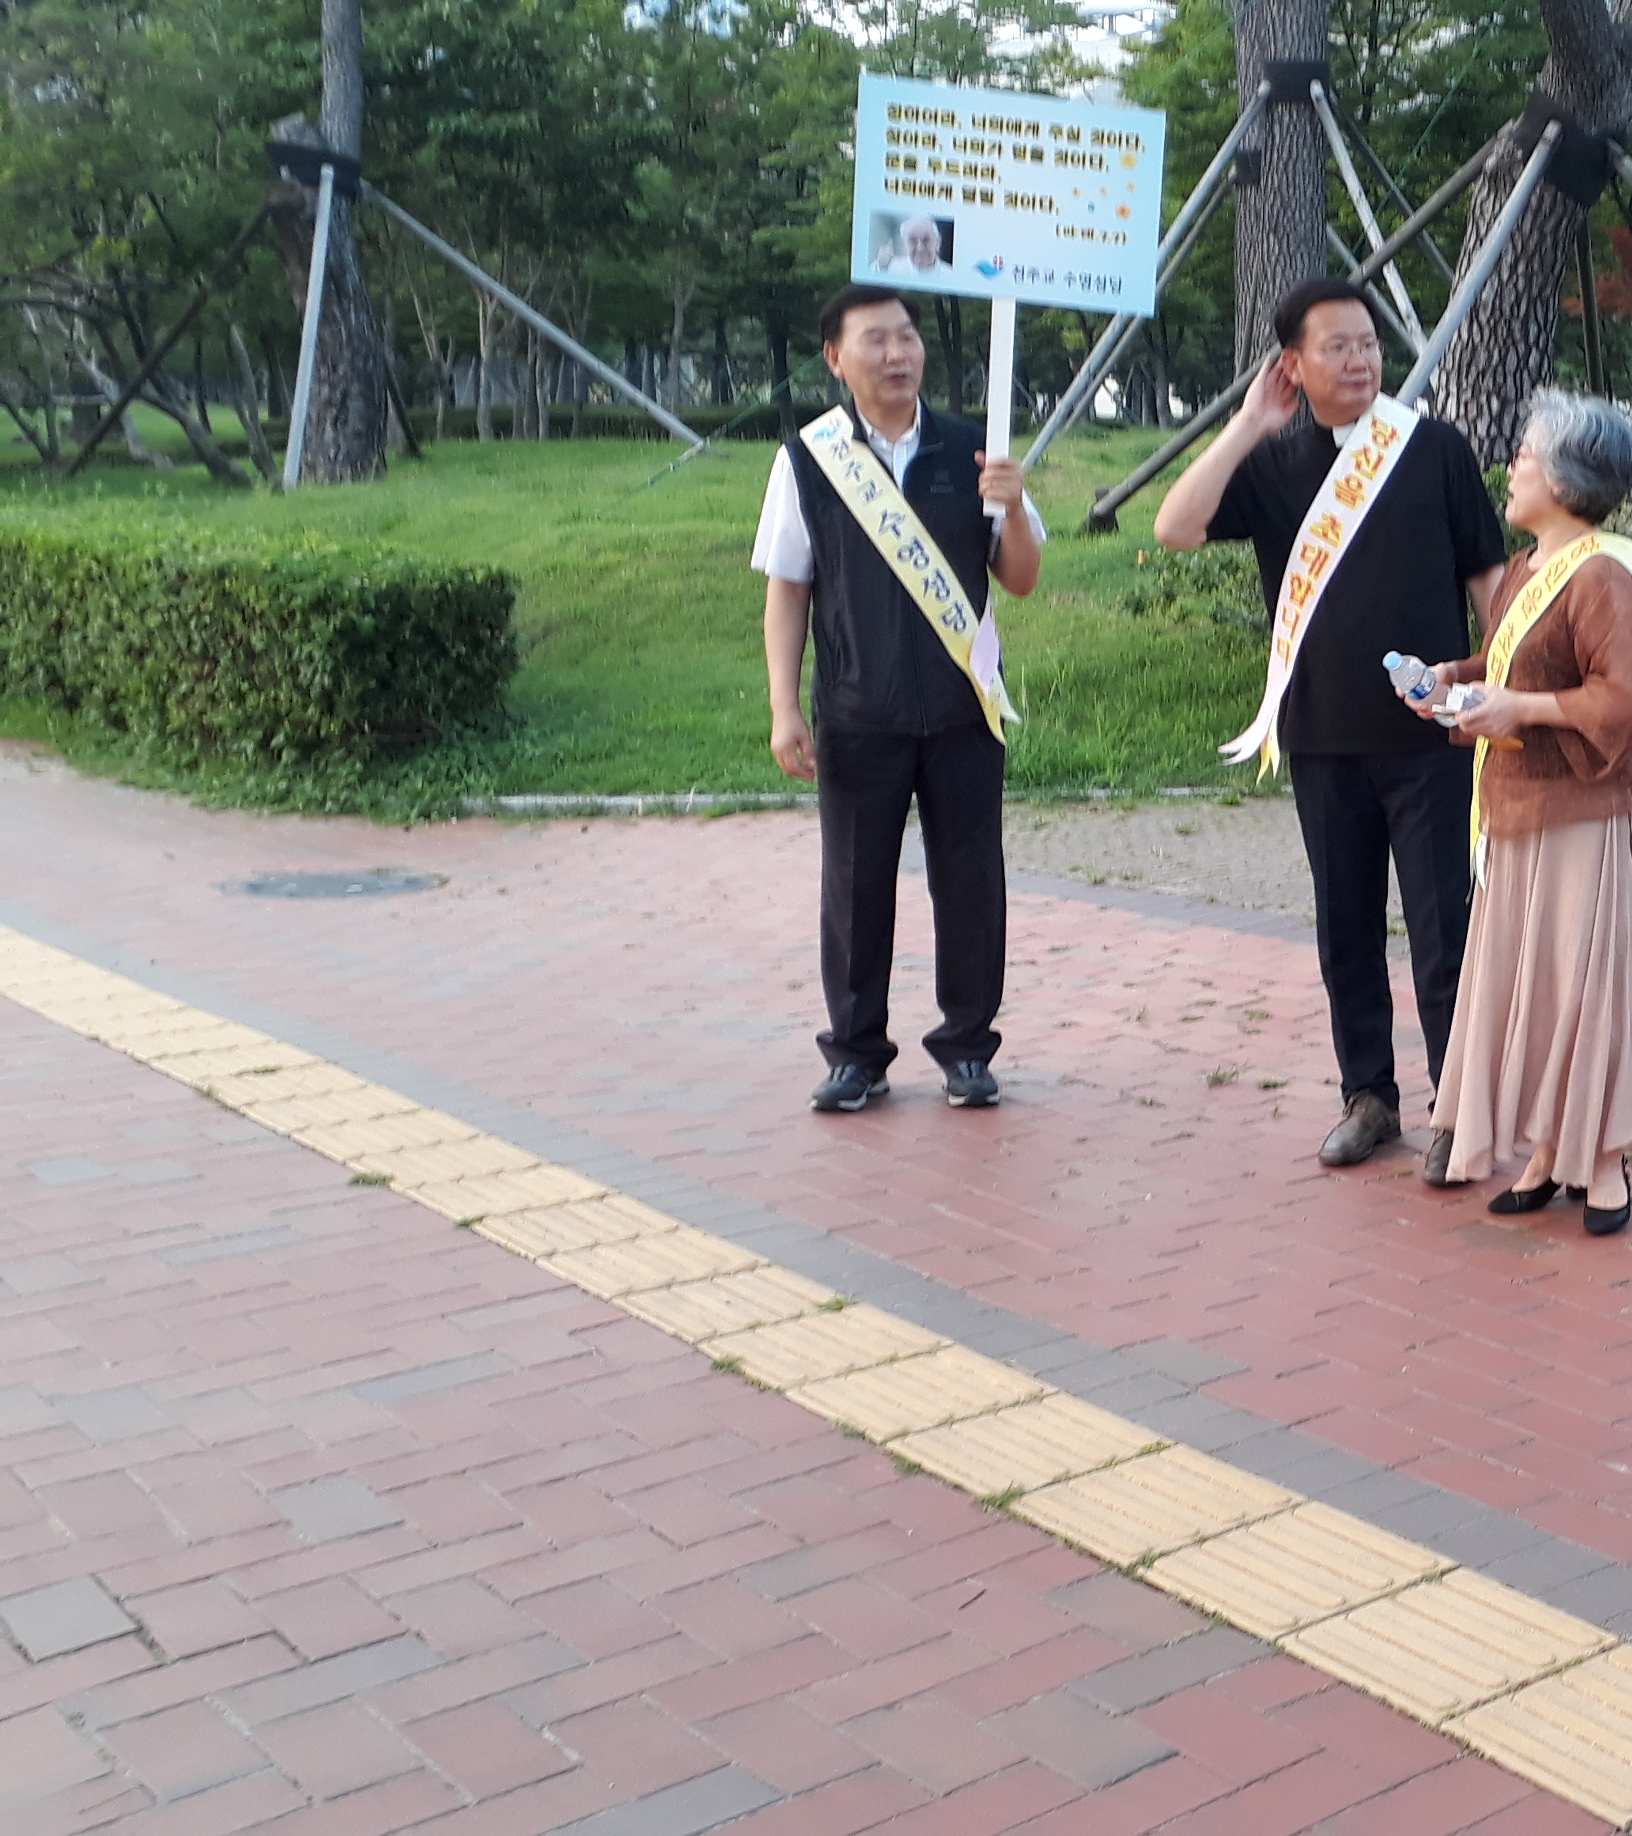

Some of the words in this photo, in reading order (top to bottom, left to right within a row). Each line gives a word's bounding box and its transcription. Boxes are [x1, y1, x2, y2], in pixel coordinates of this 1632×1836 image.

[831, 435, 883, 505] 천주교
[877, 508, 968, 634] 수영성당
[1276, 511, 1346, 674] 초대합니다
